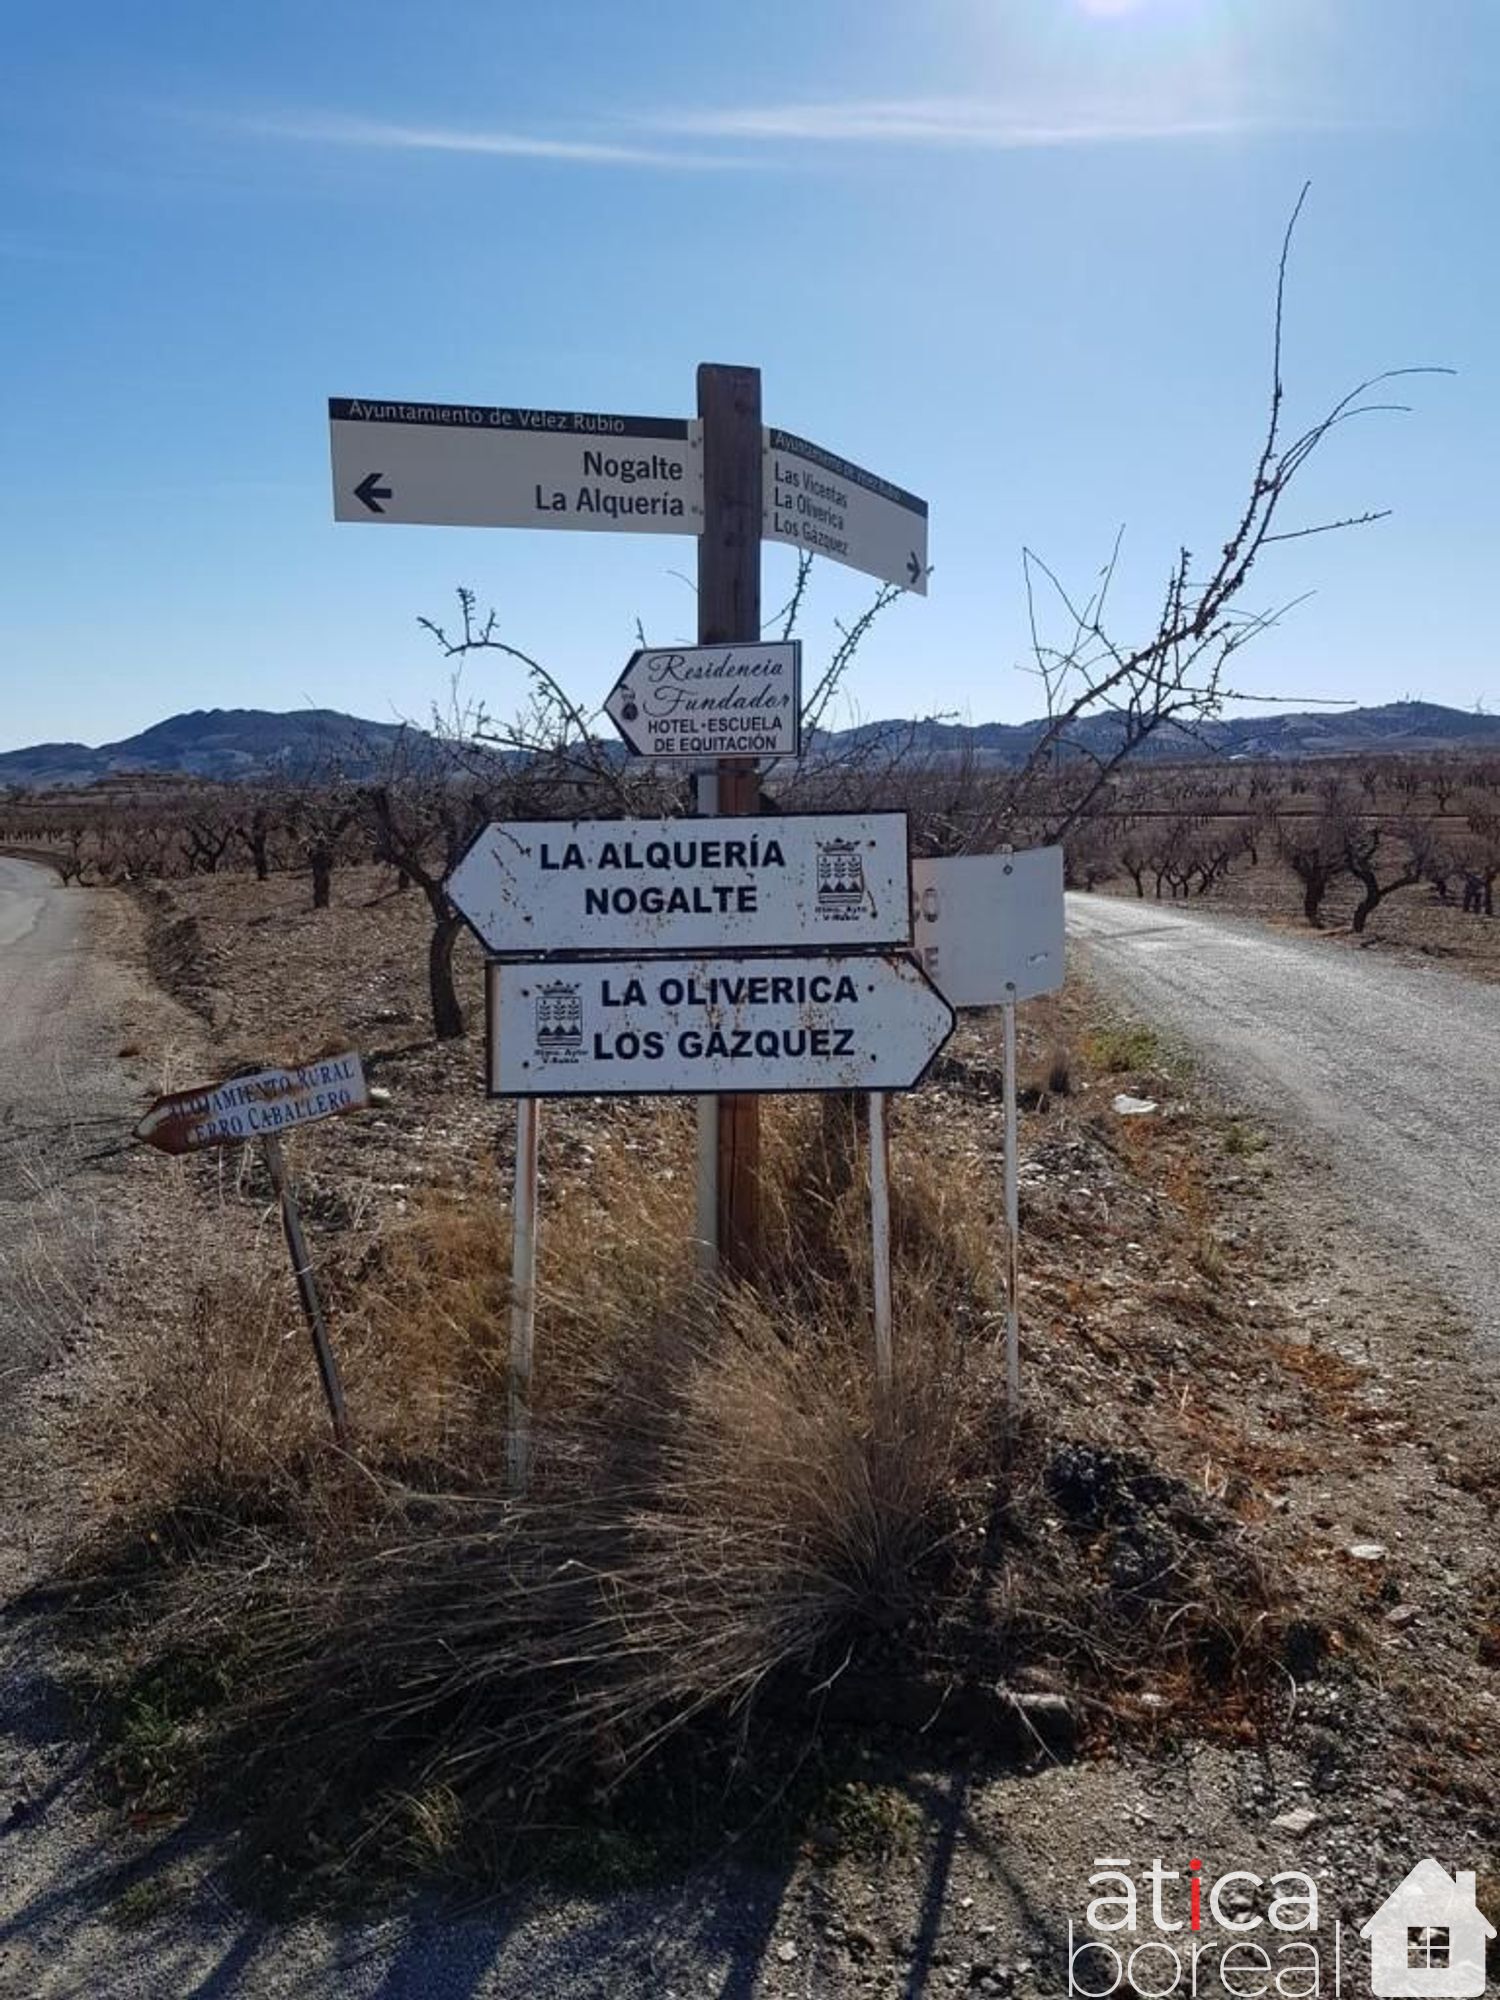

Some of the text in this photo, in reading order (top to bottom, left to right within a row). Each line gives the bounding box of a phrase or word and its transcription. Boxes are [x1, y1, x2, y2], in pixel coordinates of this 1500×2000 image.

[349, 400, 482, 424] Ayuntamiento
[489, 408, 512, 425] de
[574, 413, 625, 433] Rubio
[583, 451, 683, 484] Nogalte
[775, 461, 799, 488] Las
[535, 485, 685, 518] La Alquería
[774, 487, 845, 531] La Oliverica
[774, 512, 799, 537] Los
[648, 652, 783, 683] Residencia
[643, 684, 791, 718] Fundador
[654, 732, 777, 753] DE EQUITACIÓN
[539, 834, 786, 871] LA ALQUERÍA
[584, 885, 759, 916] NOGALTE
[601, 975, 859, 1008] LA OLIVERICA
[593, 1031, 664, 1061] LOS
[296, 1060, 355, 1091] RURAL
[247, 1088, 351, 1131] CABALLERO
